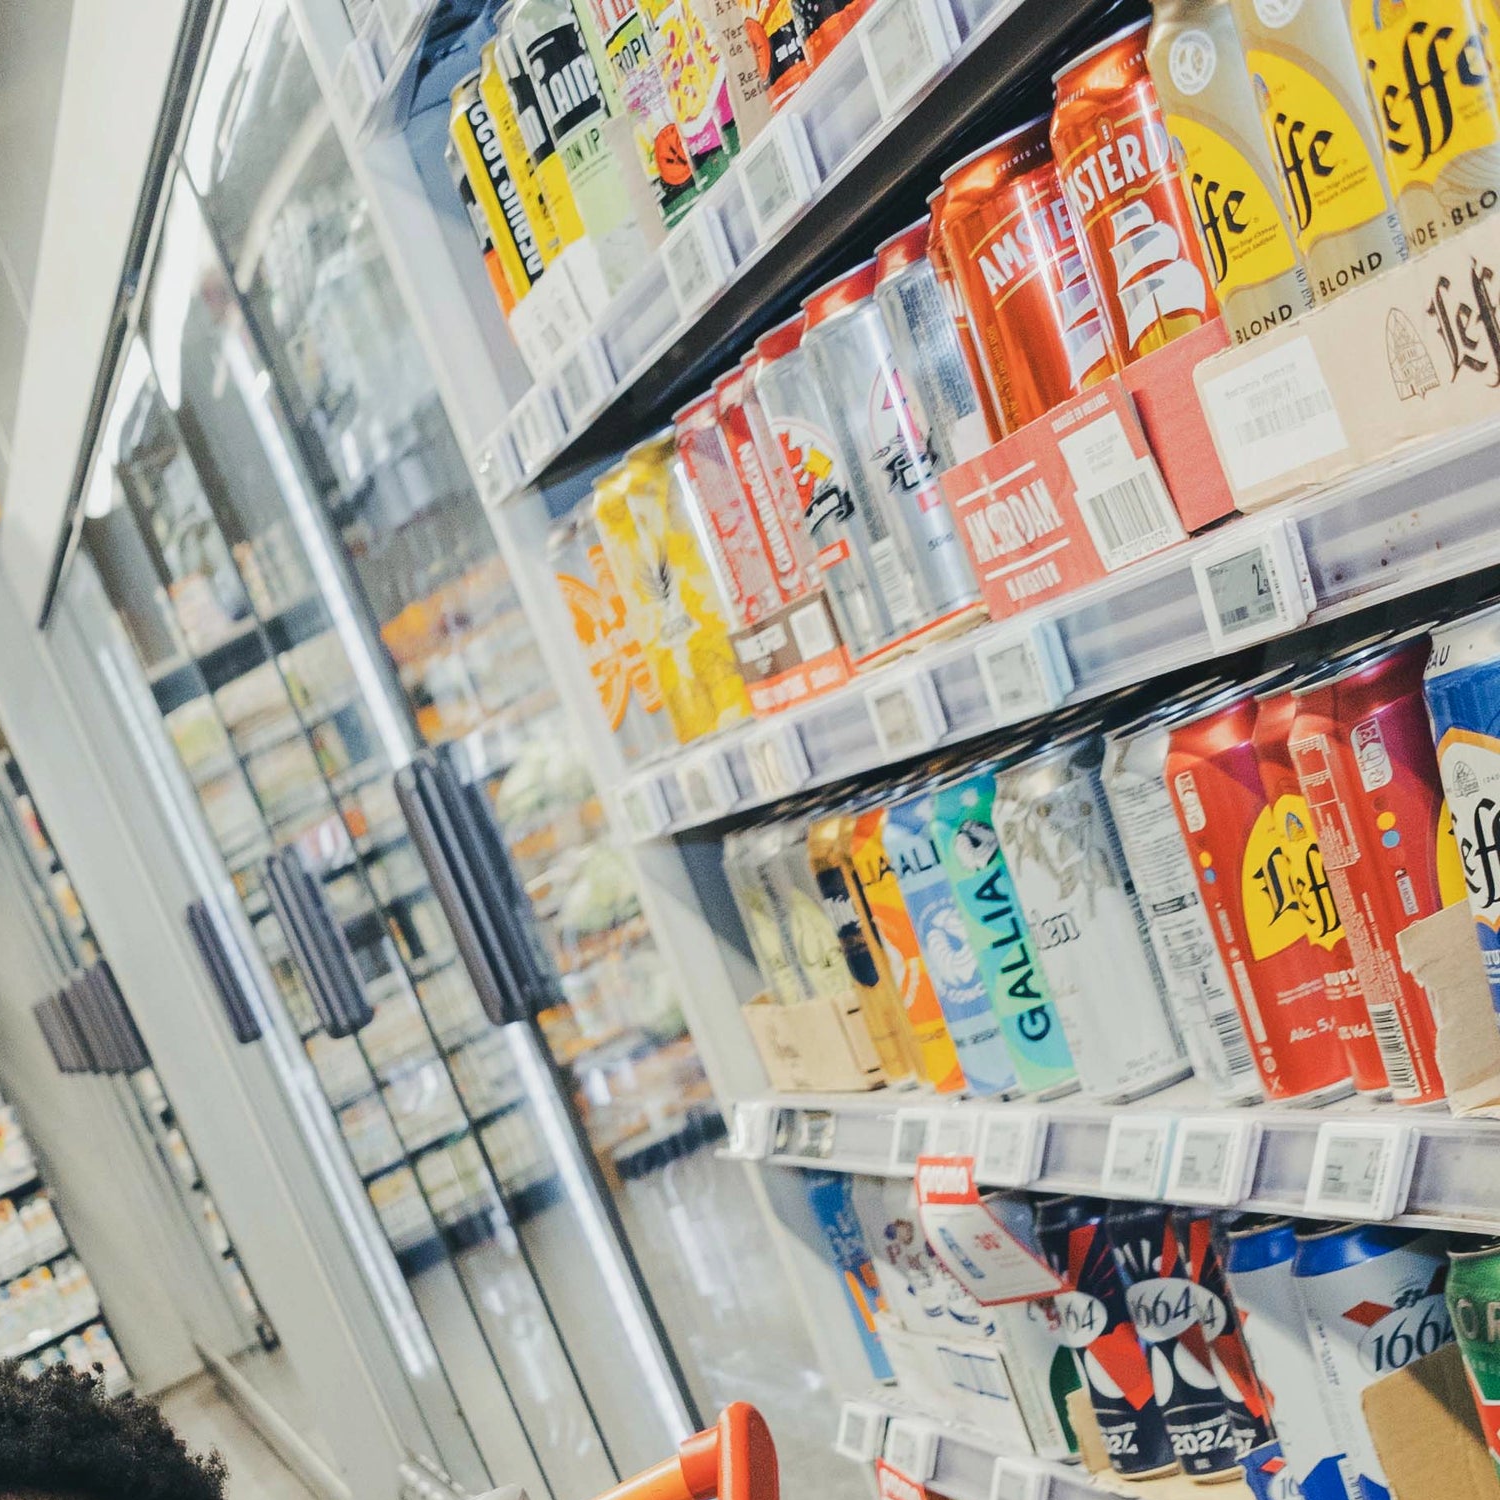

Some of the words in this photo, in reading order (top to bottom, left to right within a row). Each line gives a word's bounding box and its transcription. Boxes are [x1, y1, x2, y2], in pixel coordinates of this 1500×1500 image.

[1320, 252, 1382, 297] BLOND
[1235, 304, 1293, 344] BLOND
[975, 870, 1052, 1042] GALLIA
